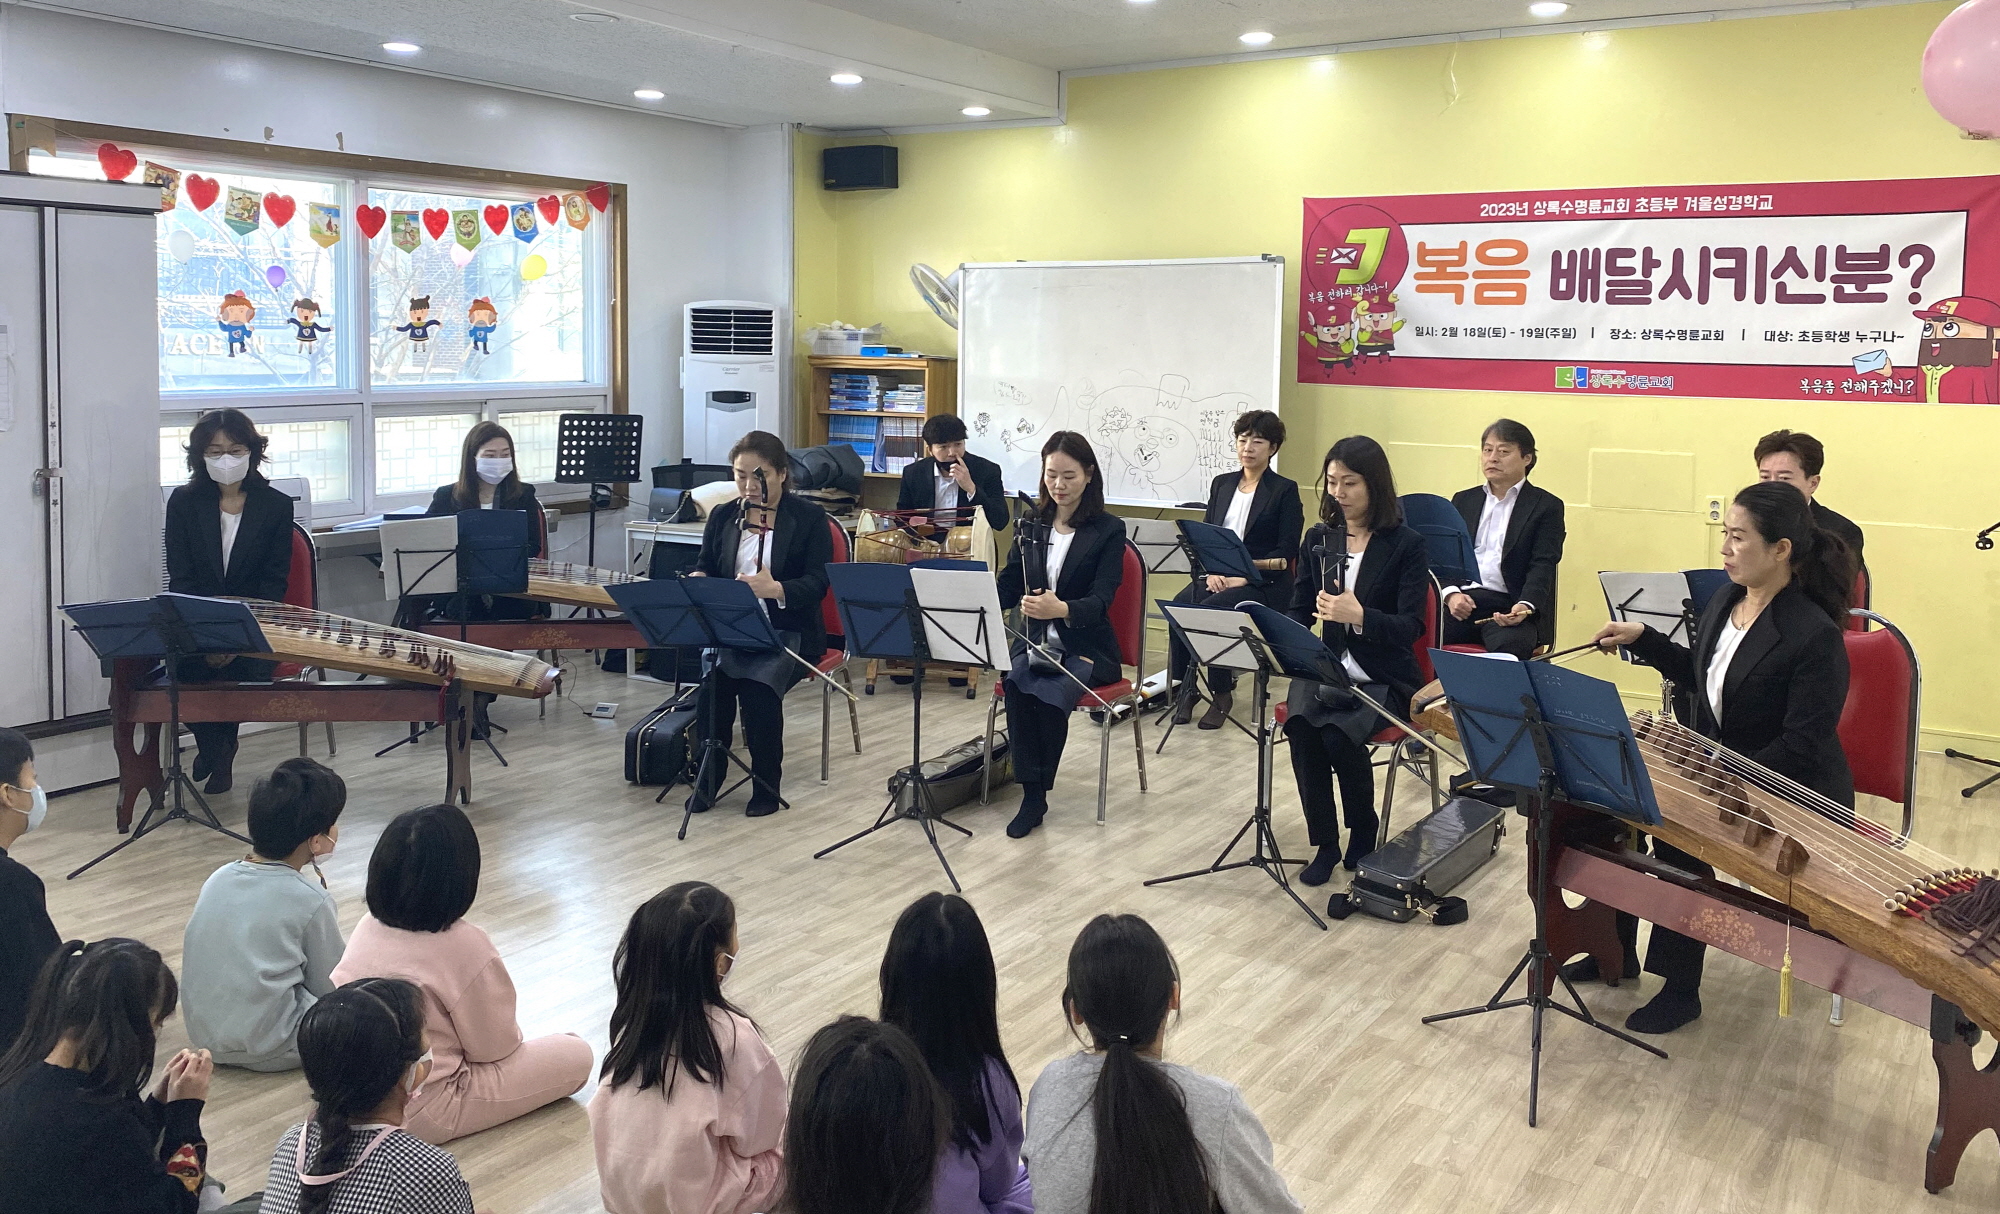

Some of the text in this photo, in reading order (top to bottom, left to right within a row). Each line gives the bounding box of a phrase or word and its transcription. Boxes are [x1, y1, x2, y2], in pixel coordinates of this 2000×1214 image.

[1480, 194, 1774, 217] 2023년 상록수명륜교회 초등부 겨울성경학교
[1413, 238, 1936, 306] 복음 배달시키신분?
[1308, 291, 1325, 304] 복음
[1327, 286, 1353, 301] 전하러
[1415, 326, 1438, 338] 일시:
[1441, 326, 1459, 338] 2월
[1463, 326, 1507, 339] 18일(토)
[1519, 327, 1578, 340] 19일(주일)
[1609, 328, 1725, 342] 장소: 상록수명륜교회
[1764, 330, 1905, 344] 대상: 초등학생 누구나~
[1589, 374, 1674, 391] 상록수명륜교회
[1799, 377, 1915, 397] 복음좀 전해주겠니?
